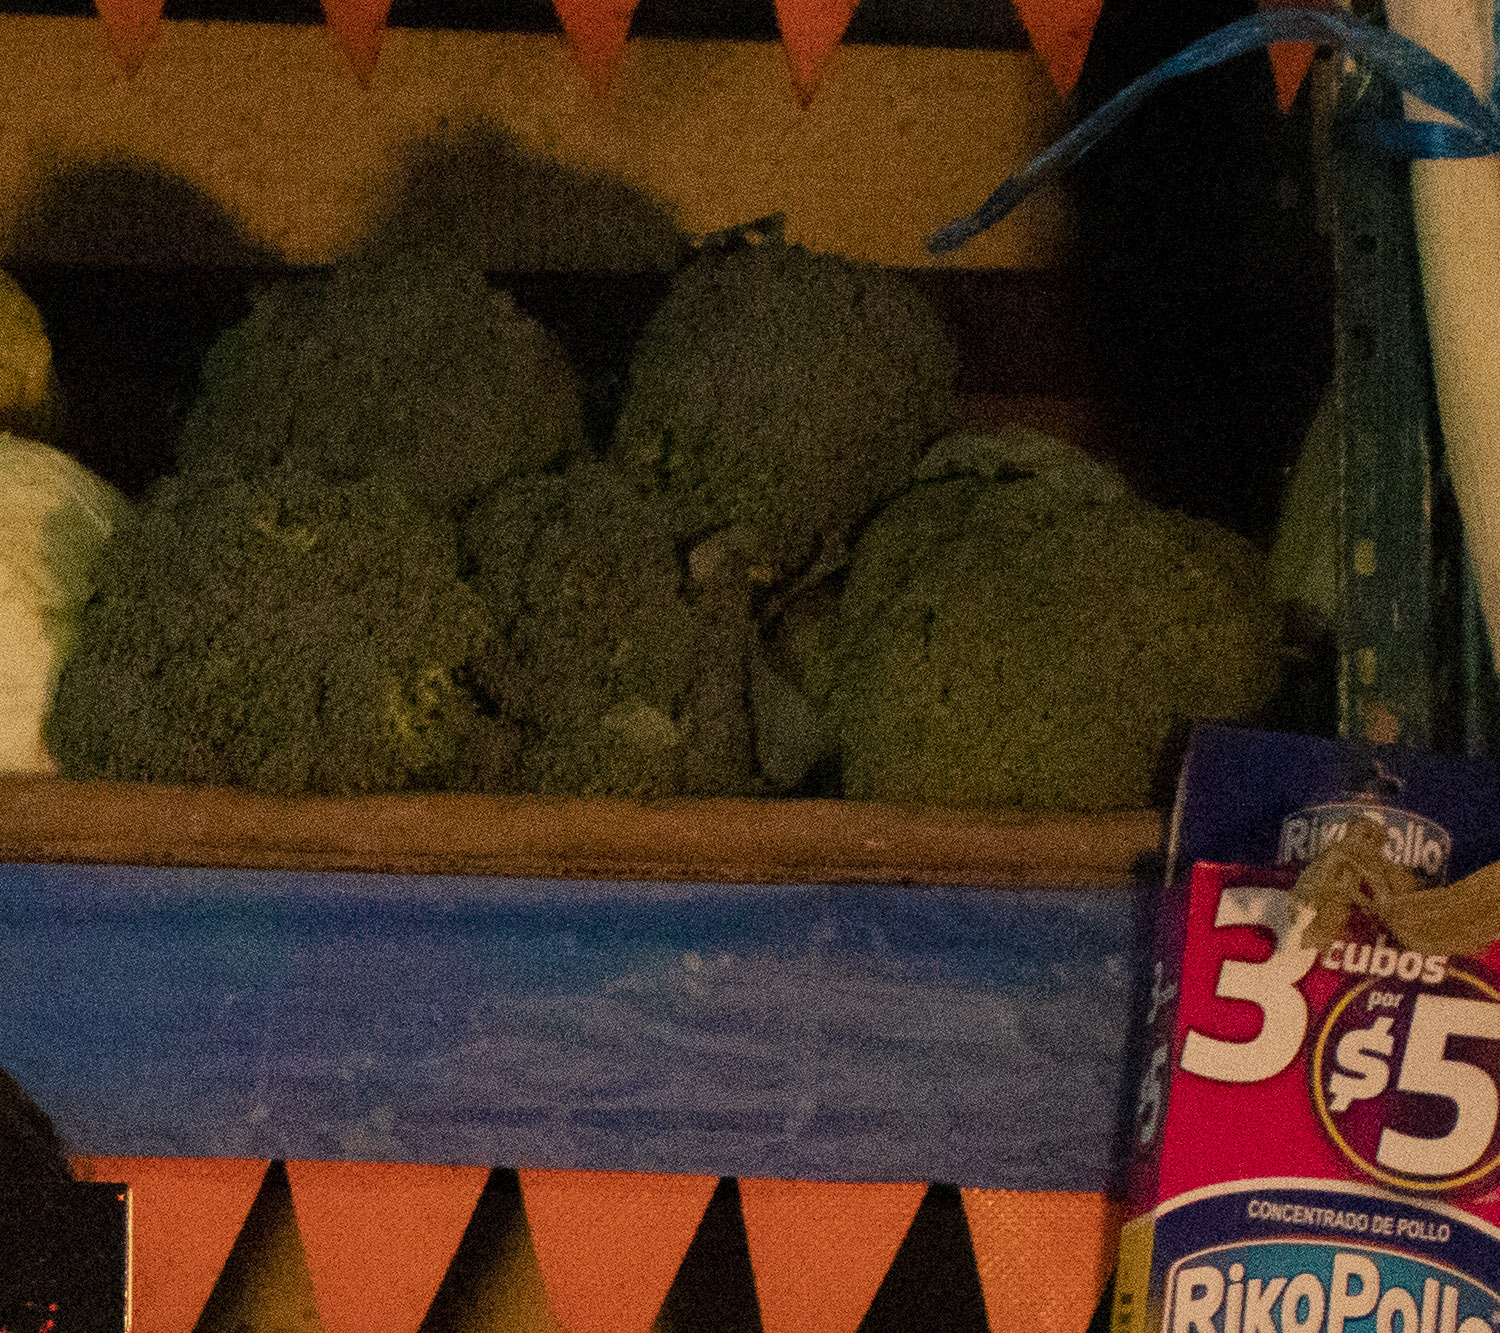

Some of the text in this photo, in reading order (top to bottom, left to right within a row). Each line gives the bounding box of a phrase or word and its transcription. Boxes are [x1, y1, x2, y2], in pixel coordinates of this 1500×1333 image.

[1179, 886, 1318, 1084] 3
[1321, 936, 1448, 984] cubos
[1367, 990, 1403, 1012] por
[1248, 1199, 1451, 1243] CONCENTRADO DE POLLO
